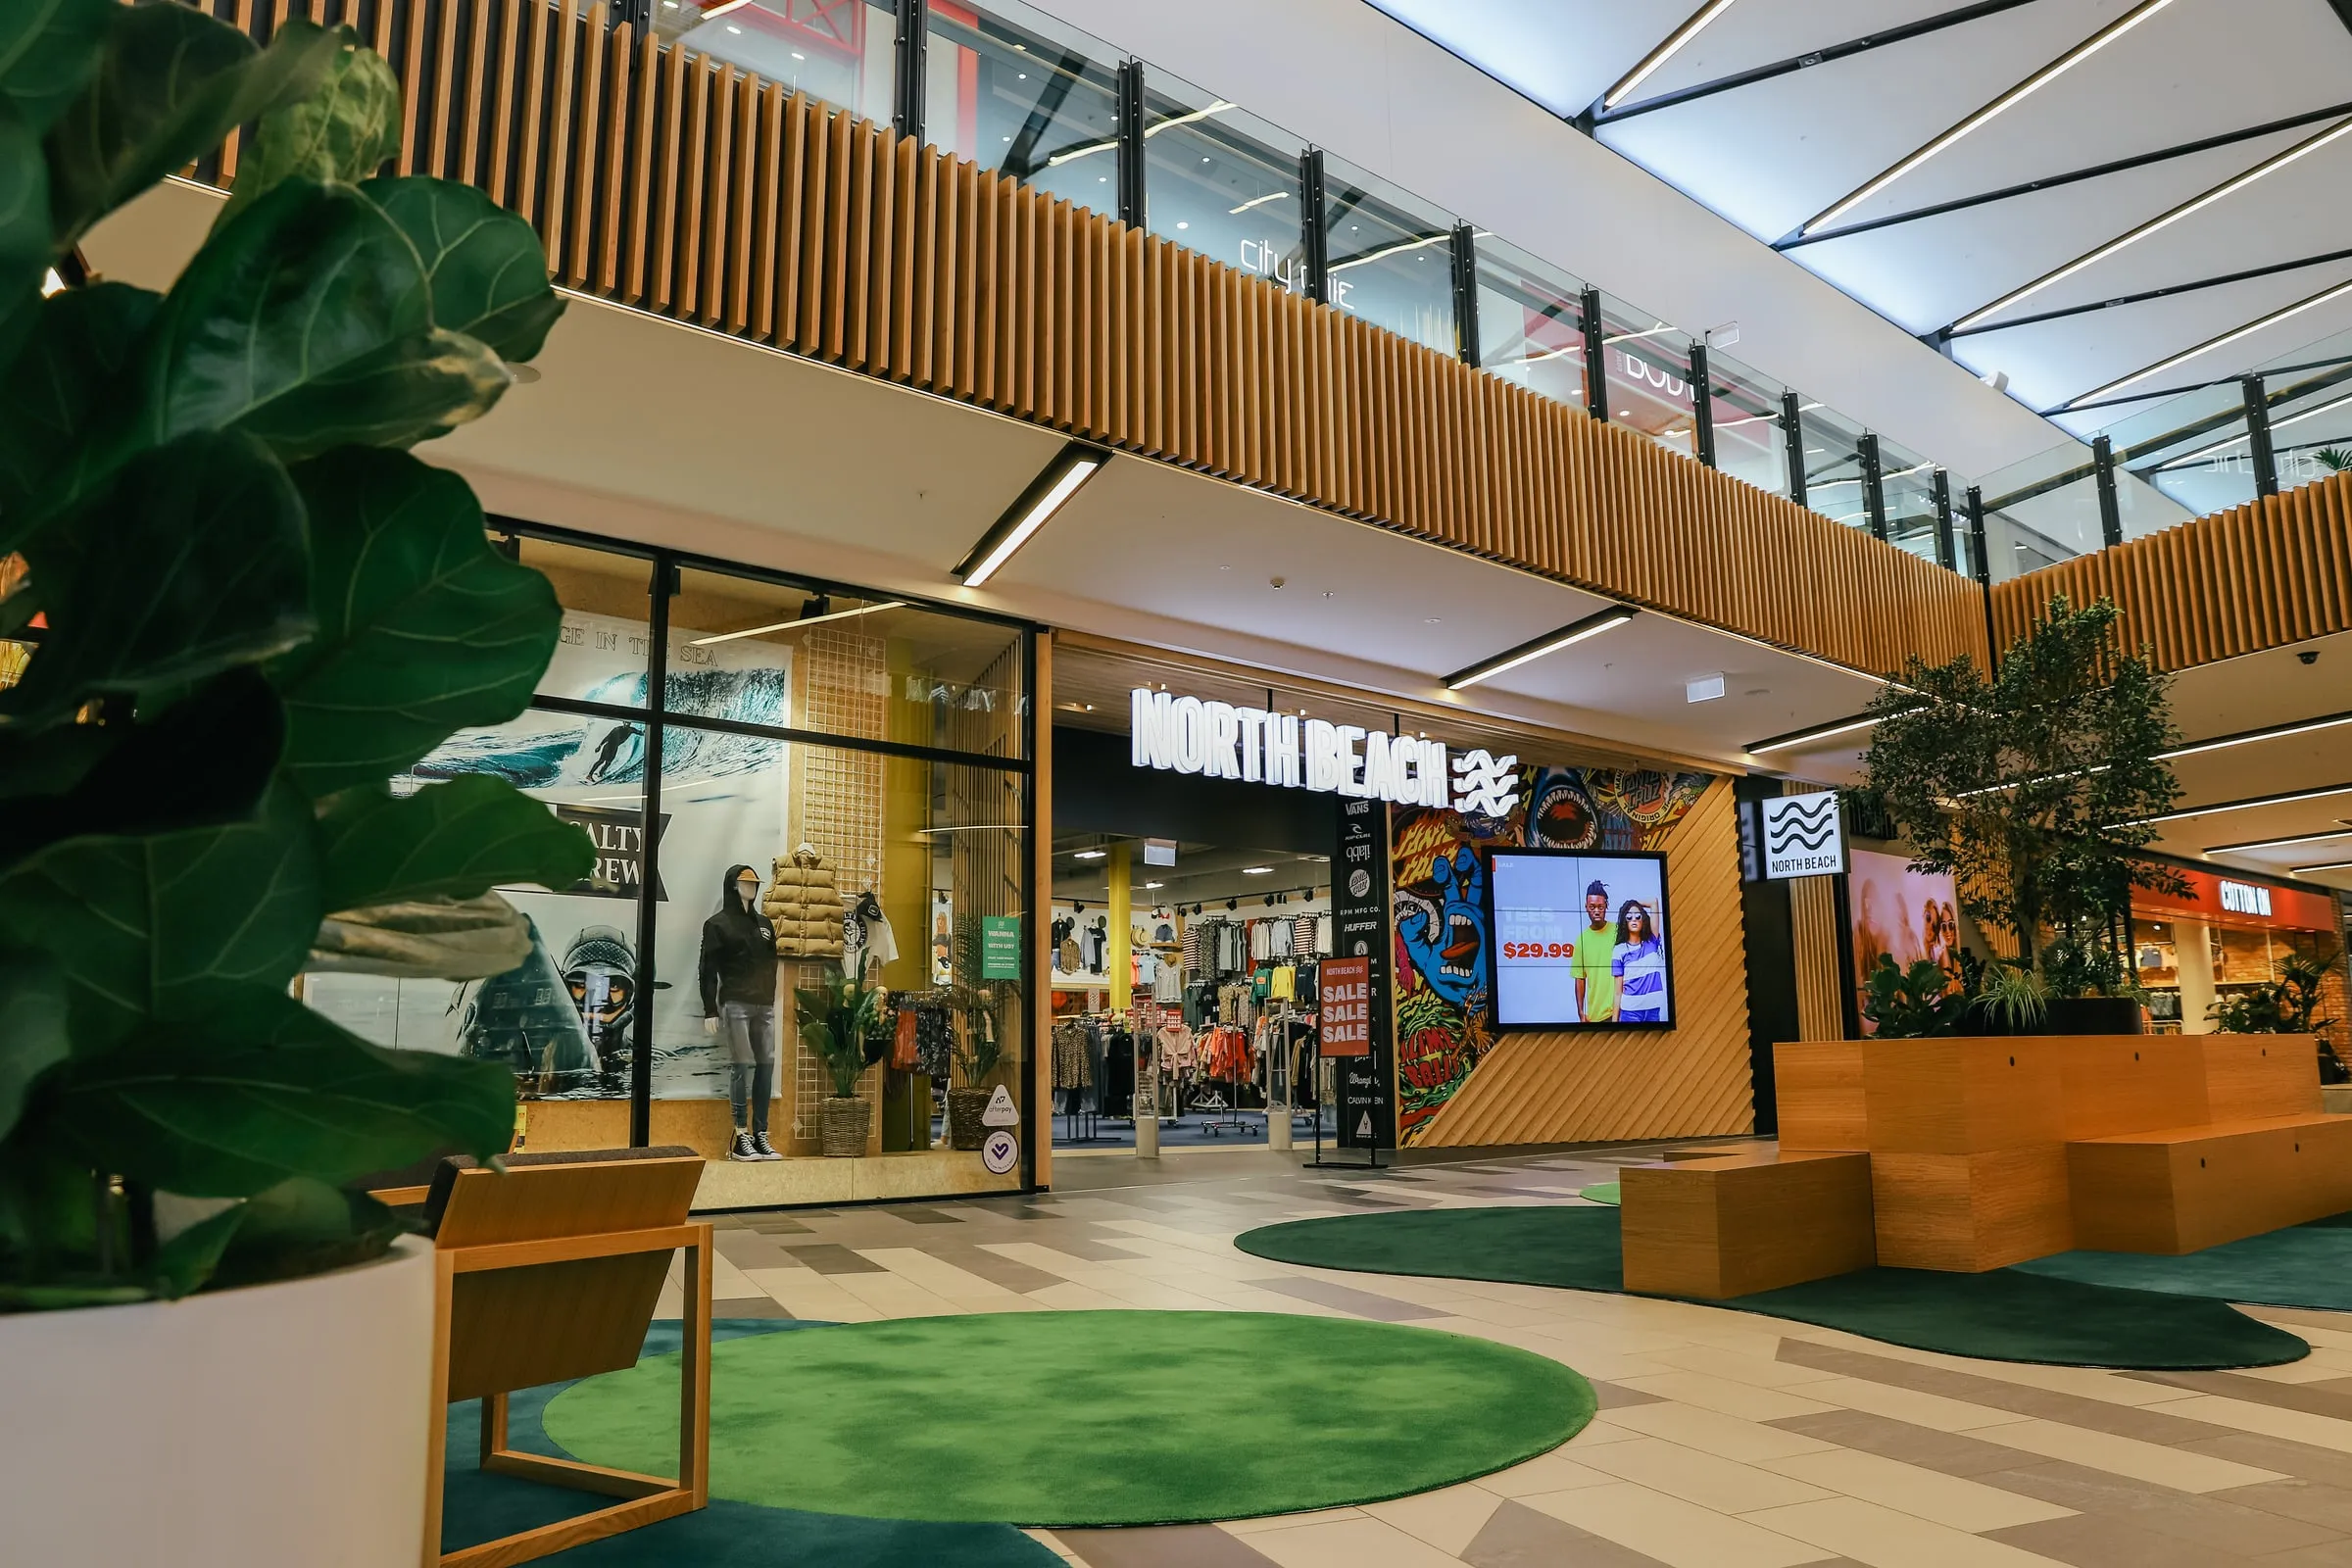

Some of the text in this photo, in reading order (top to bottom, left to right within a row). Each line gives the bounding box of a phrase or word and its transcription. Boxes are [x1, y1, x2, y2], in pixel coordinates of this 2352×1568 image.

[1240, 239, 1293, 295] city
[595, 631, 618, 652] IN
[679, 645, 718, 667] SEA
[1130, 687, 1300, 788] NORTH
[1304, 717, 1449, 809] BEACH
[1345, 800, 1370, 816] VANS
[568, 820, 643, 853] ALTY
[577, 858, 641, 885] REW
[1772, 855, 1837, 873] NORTH BEACH
[1500, 906, 1554, 923] TEES
[1344, 920, 1378, 933] HUFFER
[1502, 924, 1564, 941] FROM
[1502, 941, 1575, 959] $29.99
[1341, 966, 1356, 975] BEACH
[1322, 982, 1367, 1004] SALE
[1322, 1003, 1368, 1023] SALE
[1322, 1023, 1368, 1044] SALE
[988, 1105, 1012, 1114] afterpay
